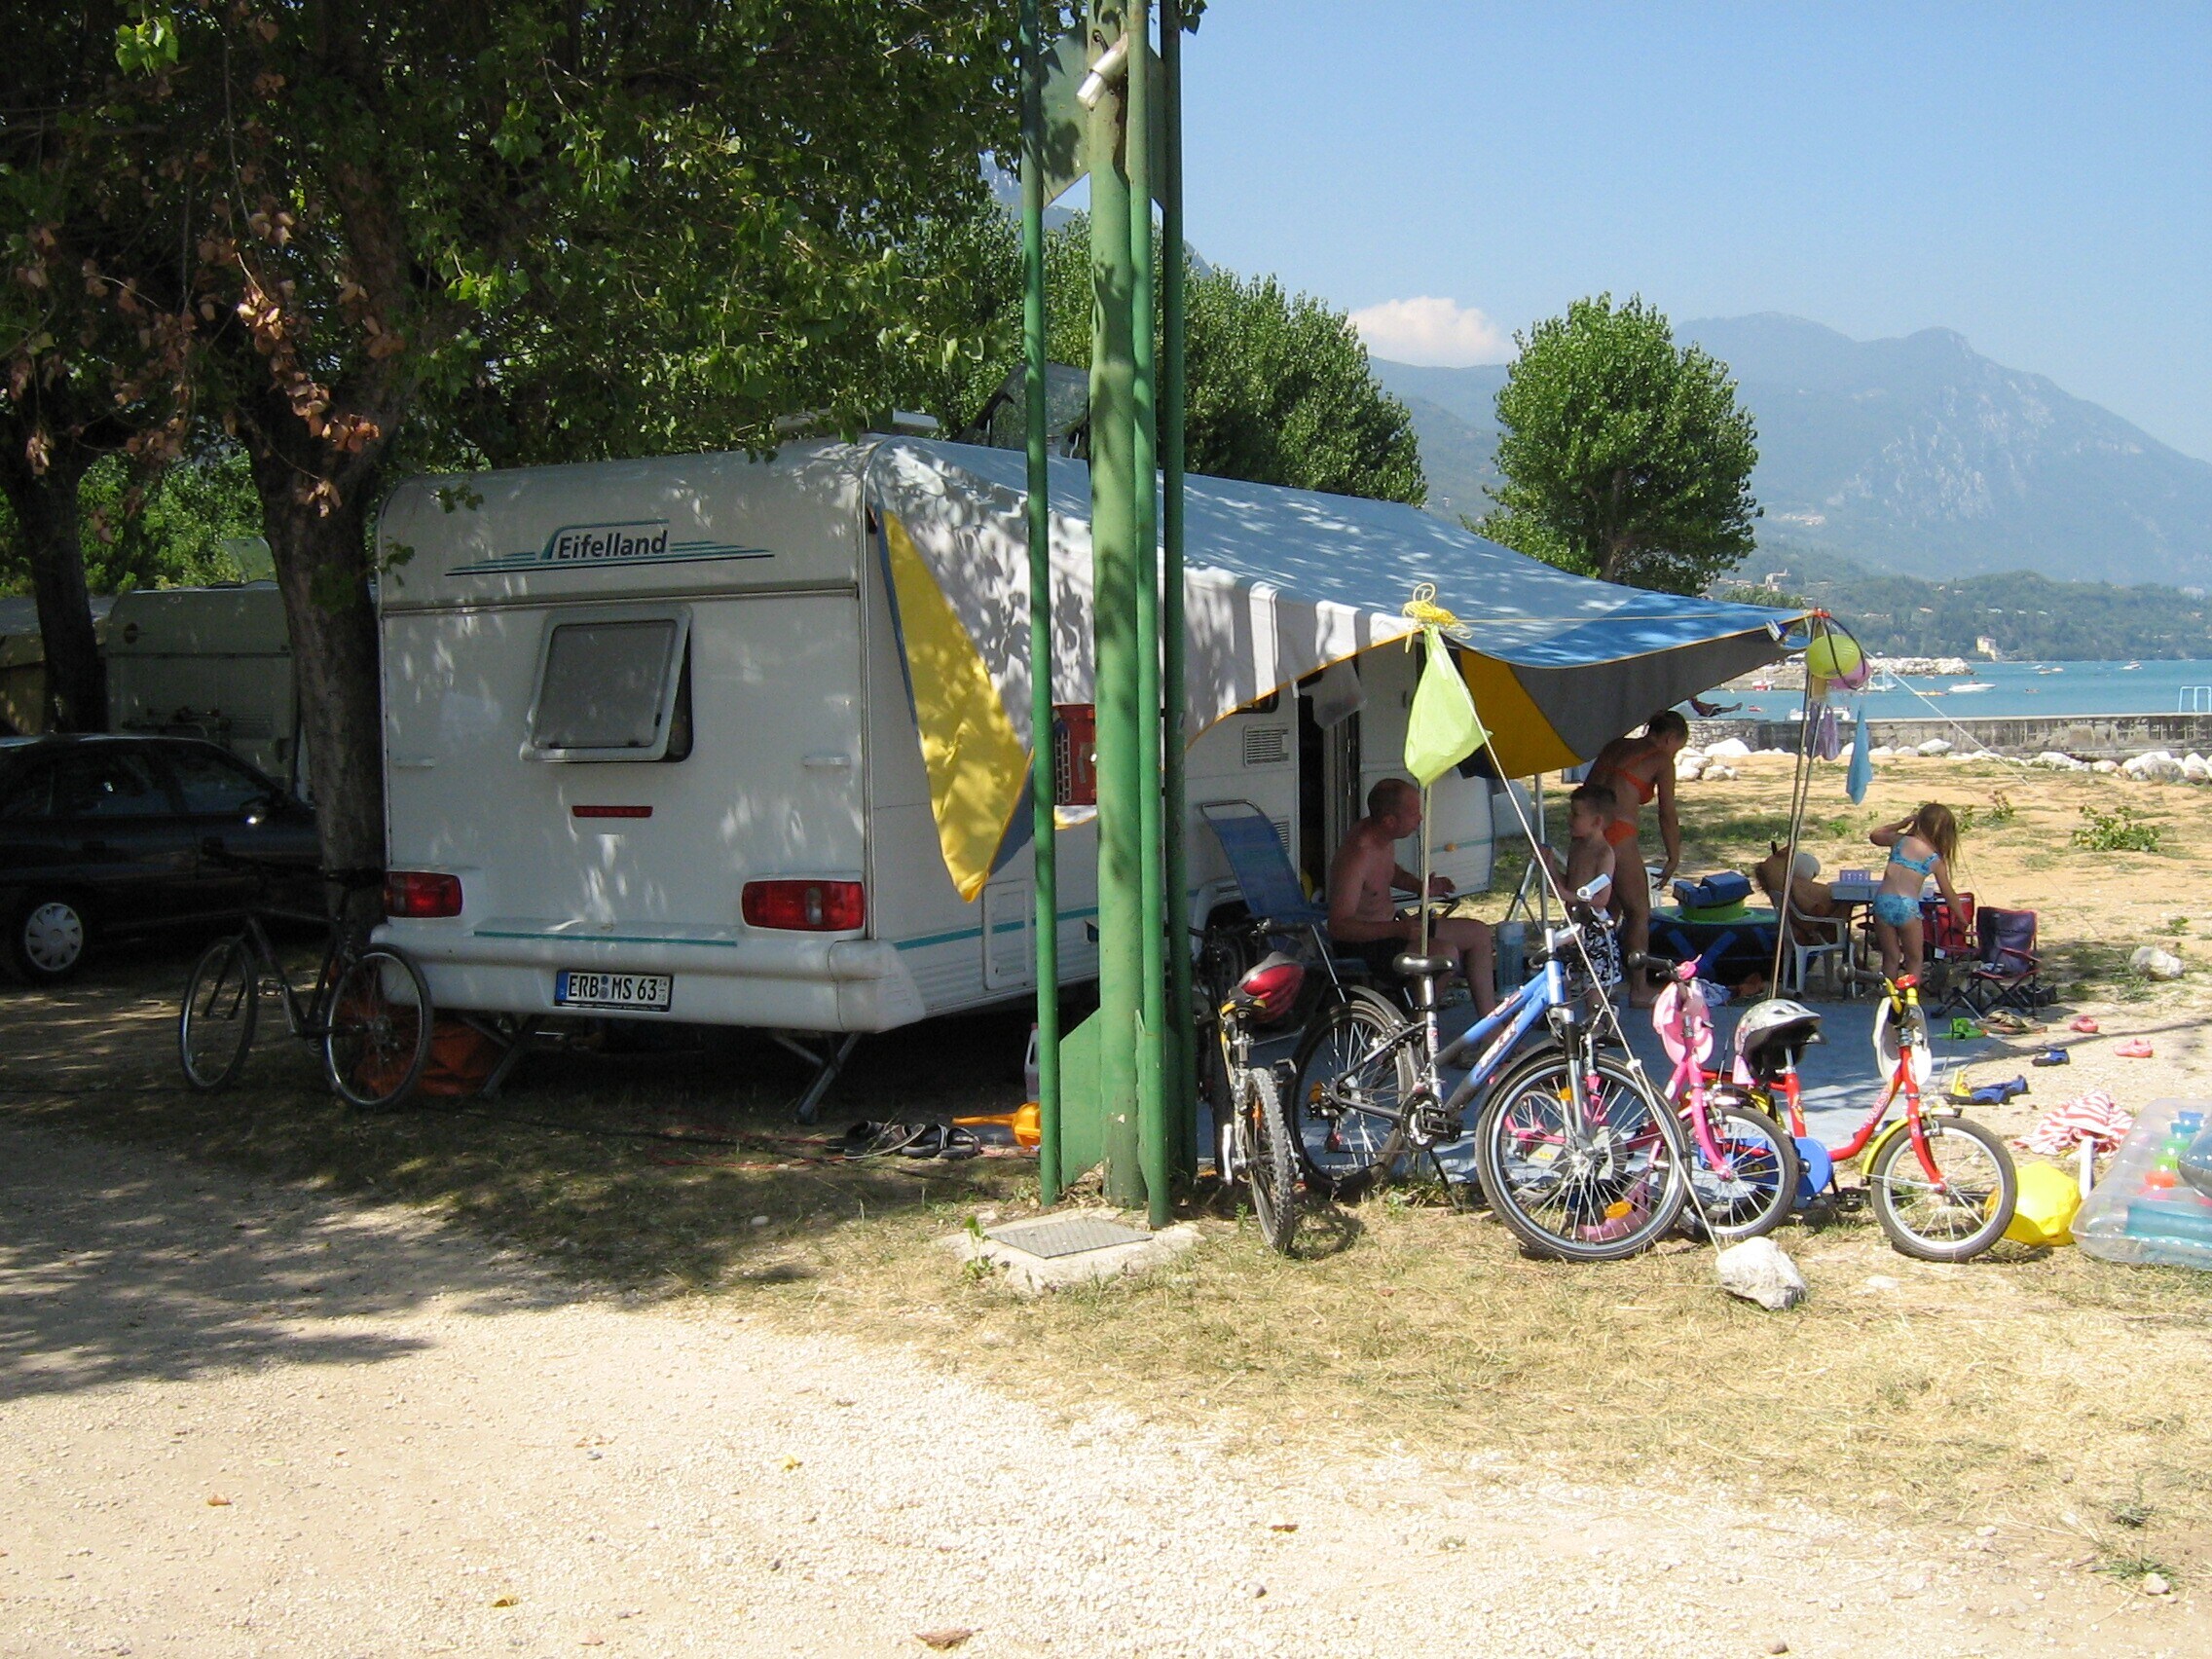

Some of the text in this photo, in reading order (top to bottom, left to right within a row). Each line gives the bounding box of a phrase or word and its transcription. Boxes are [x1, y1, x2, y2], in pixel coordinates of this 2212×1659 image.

[557, 530, 669, 560] Eifelland
[568, 975, 600, 998] ERB
[611, 977, 633, 1000] MS
[637, 977, 658, 1001] 63
